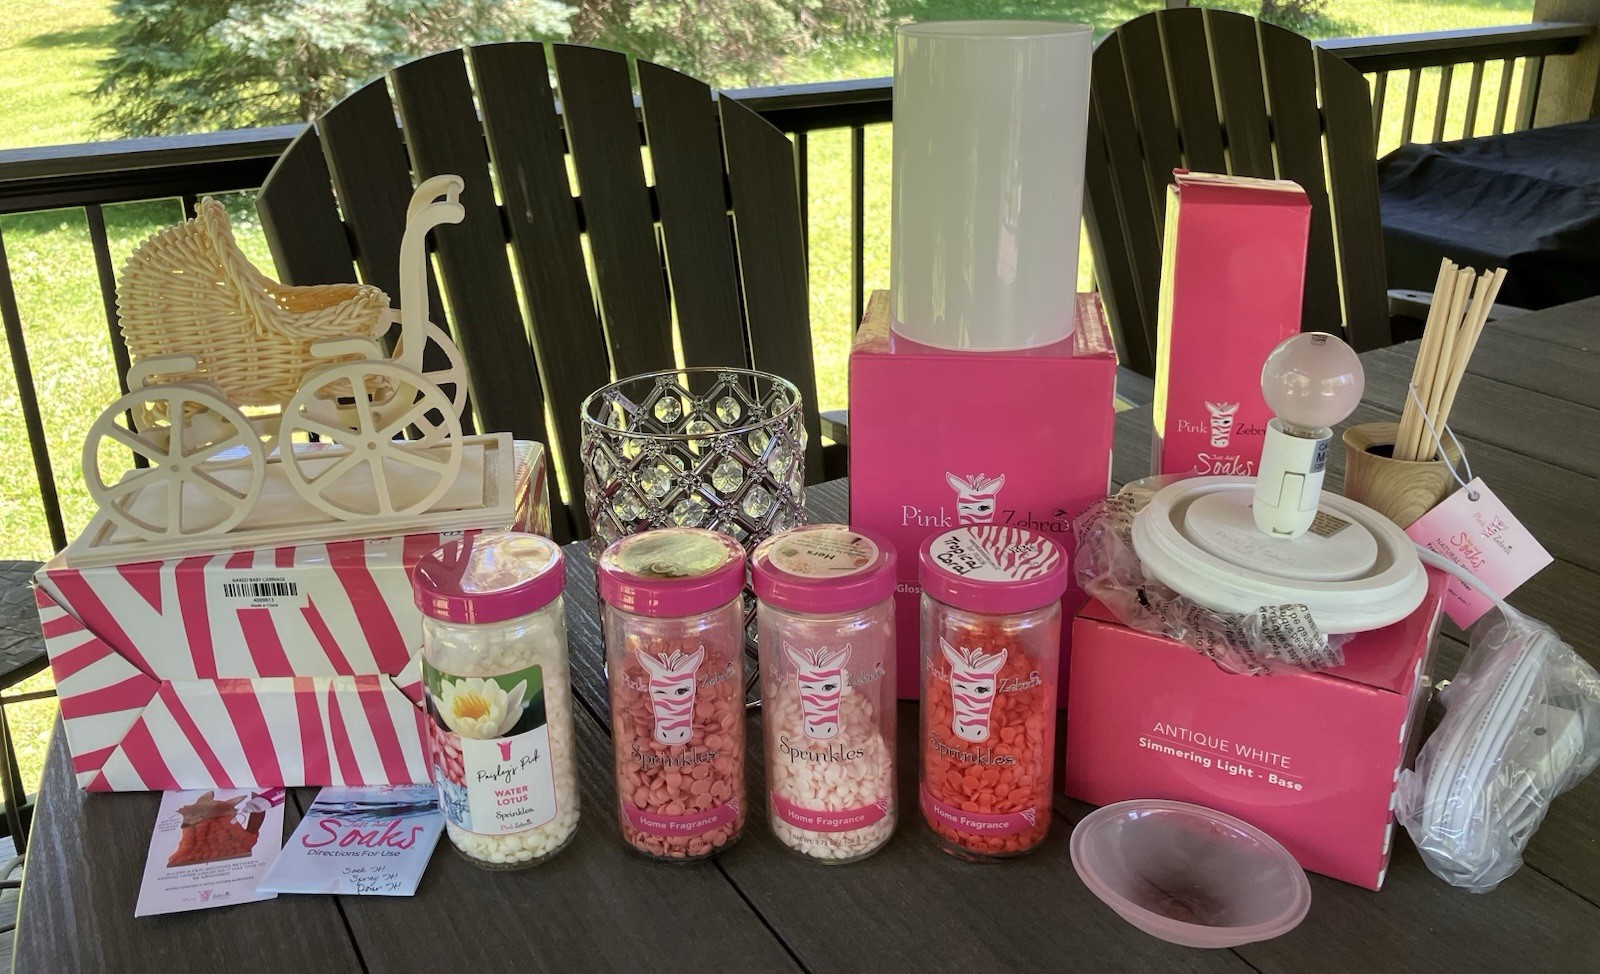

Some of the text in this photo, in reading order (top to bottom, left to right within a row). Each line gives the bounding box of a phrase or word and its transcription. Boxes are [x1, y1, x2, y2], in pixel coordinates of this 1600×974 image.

[1177, 419, 1208, 434] Pink
[1193, 452, 1255, 477] Soaks
[901, 505, 953, 528] Pink
[807, 550, 836, 560] Hers
[943, 536, 984, 571] Tropical
[1450, 532, 1485, 569] Soaks
[937, 552, 972, 577] Coral
[700, 662, 736, 688] Zebra
[846, 662, 886, 687] Zebra
[926, 656, 1042, 693] Pink Zebra
[631, 743, 716, 770] Sprinkles
[780, 735, 864, 763] Sprinkles
[930, 730, 1016, 765] Sprinkles
[1153, 721, 1291, 769] ANTIQUE WHITE
[476, 764, 518, 784] Paisley's
[1138, 737, 1212, 767] Simmering
[1217, 759, 1253, 778] Light
[1268, 773, 1303, 791] Base
[494, 785, 528, 797] WATER
[497, 794, 528, 806] LOTUS
[496, 807, 535, 820] Sprinkles
[514, 819, 533, 828] Zebra
[640, 815, 718, 831] Home Fragrance
[788, 809, 865, 827] Home Fragrance
[933, 804, 1010, 830] Home Fragrance
[302, 818, 424, 849] Soaks
[307, 849, 360, 857] Directions
